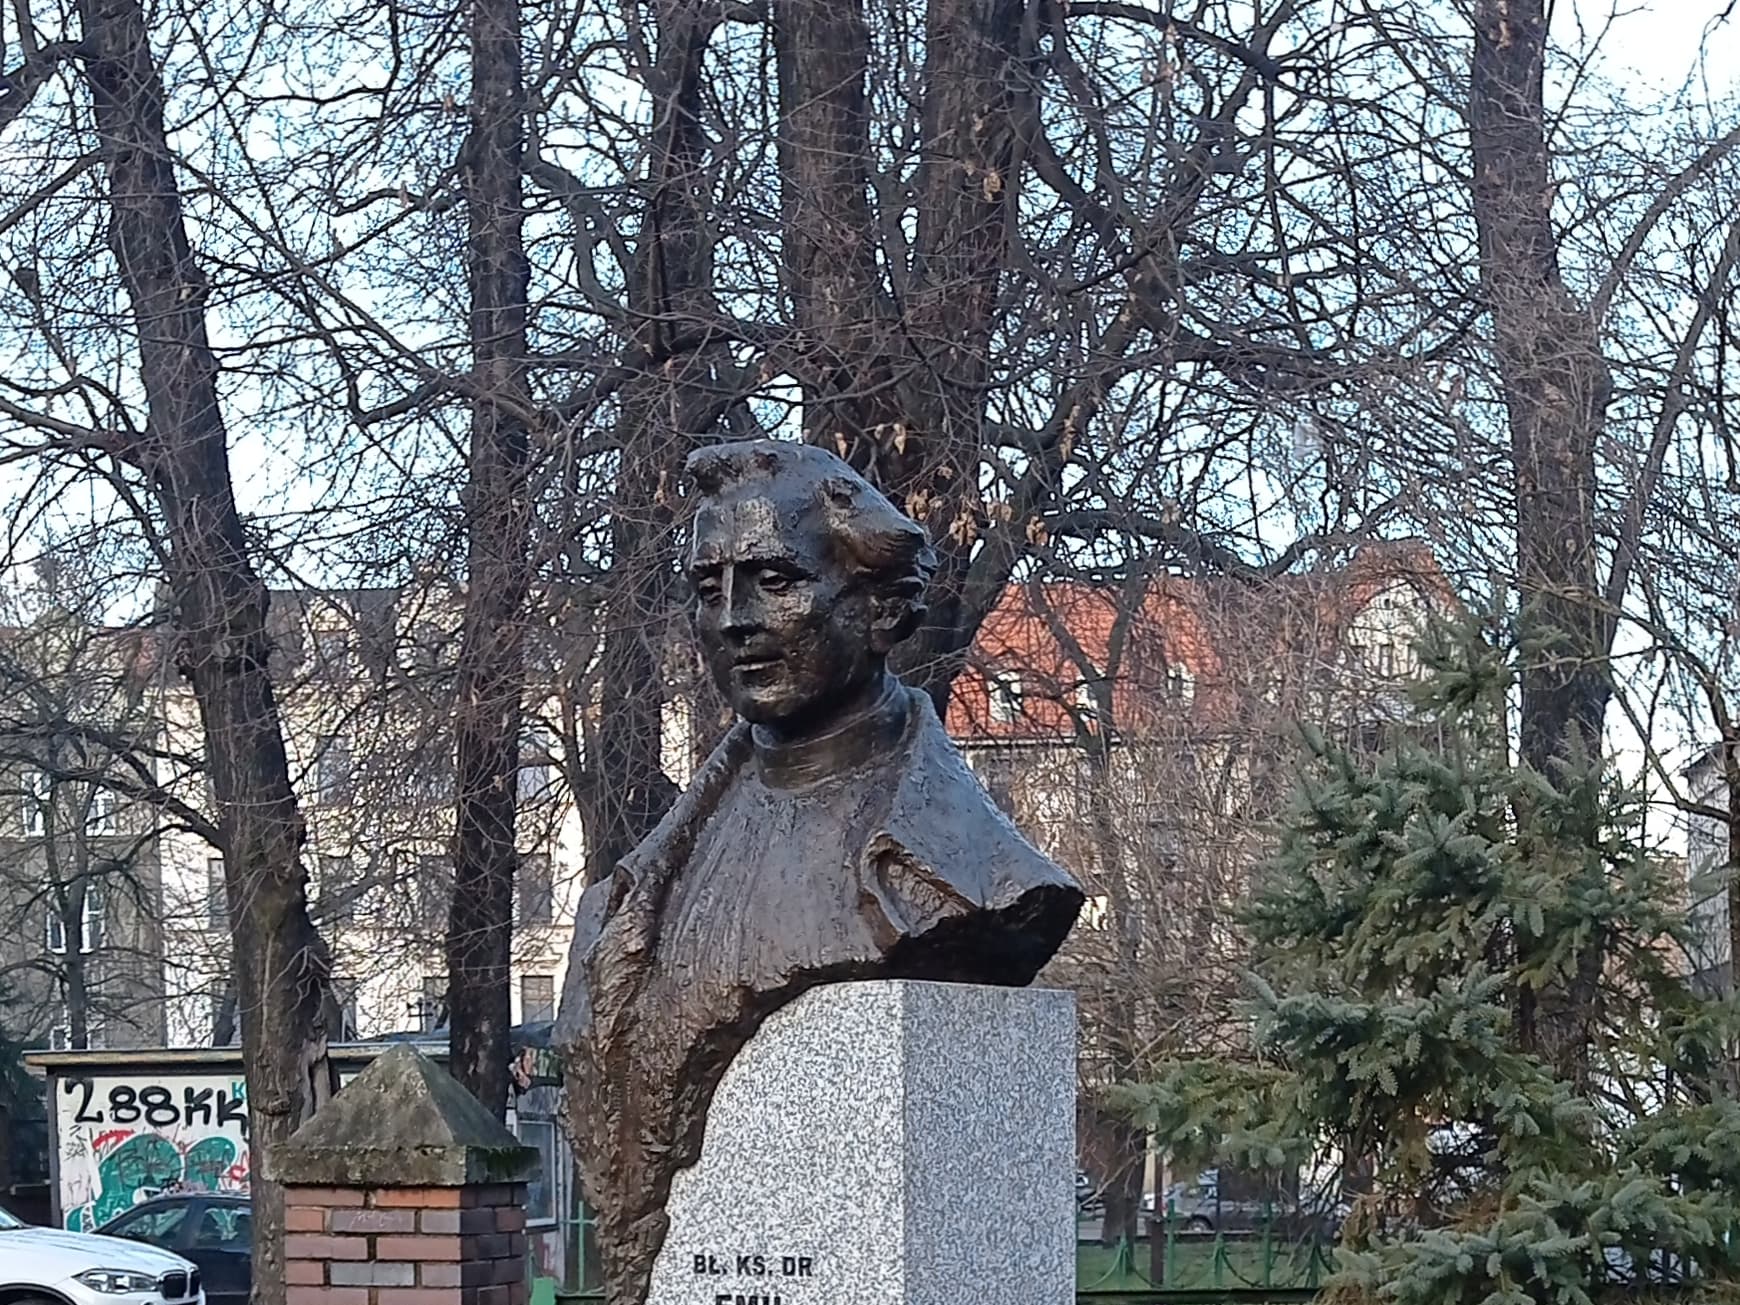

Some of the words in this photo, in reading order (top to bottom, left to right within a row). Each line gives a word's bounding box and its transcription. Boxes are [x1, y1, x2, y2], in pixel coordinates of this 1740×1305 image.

[693, 1254, 727, 1275] BŁ.
[736, 1255, 773, 1277] KS.
[782, 1256, 813, 1277] DR
